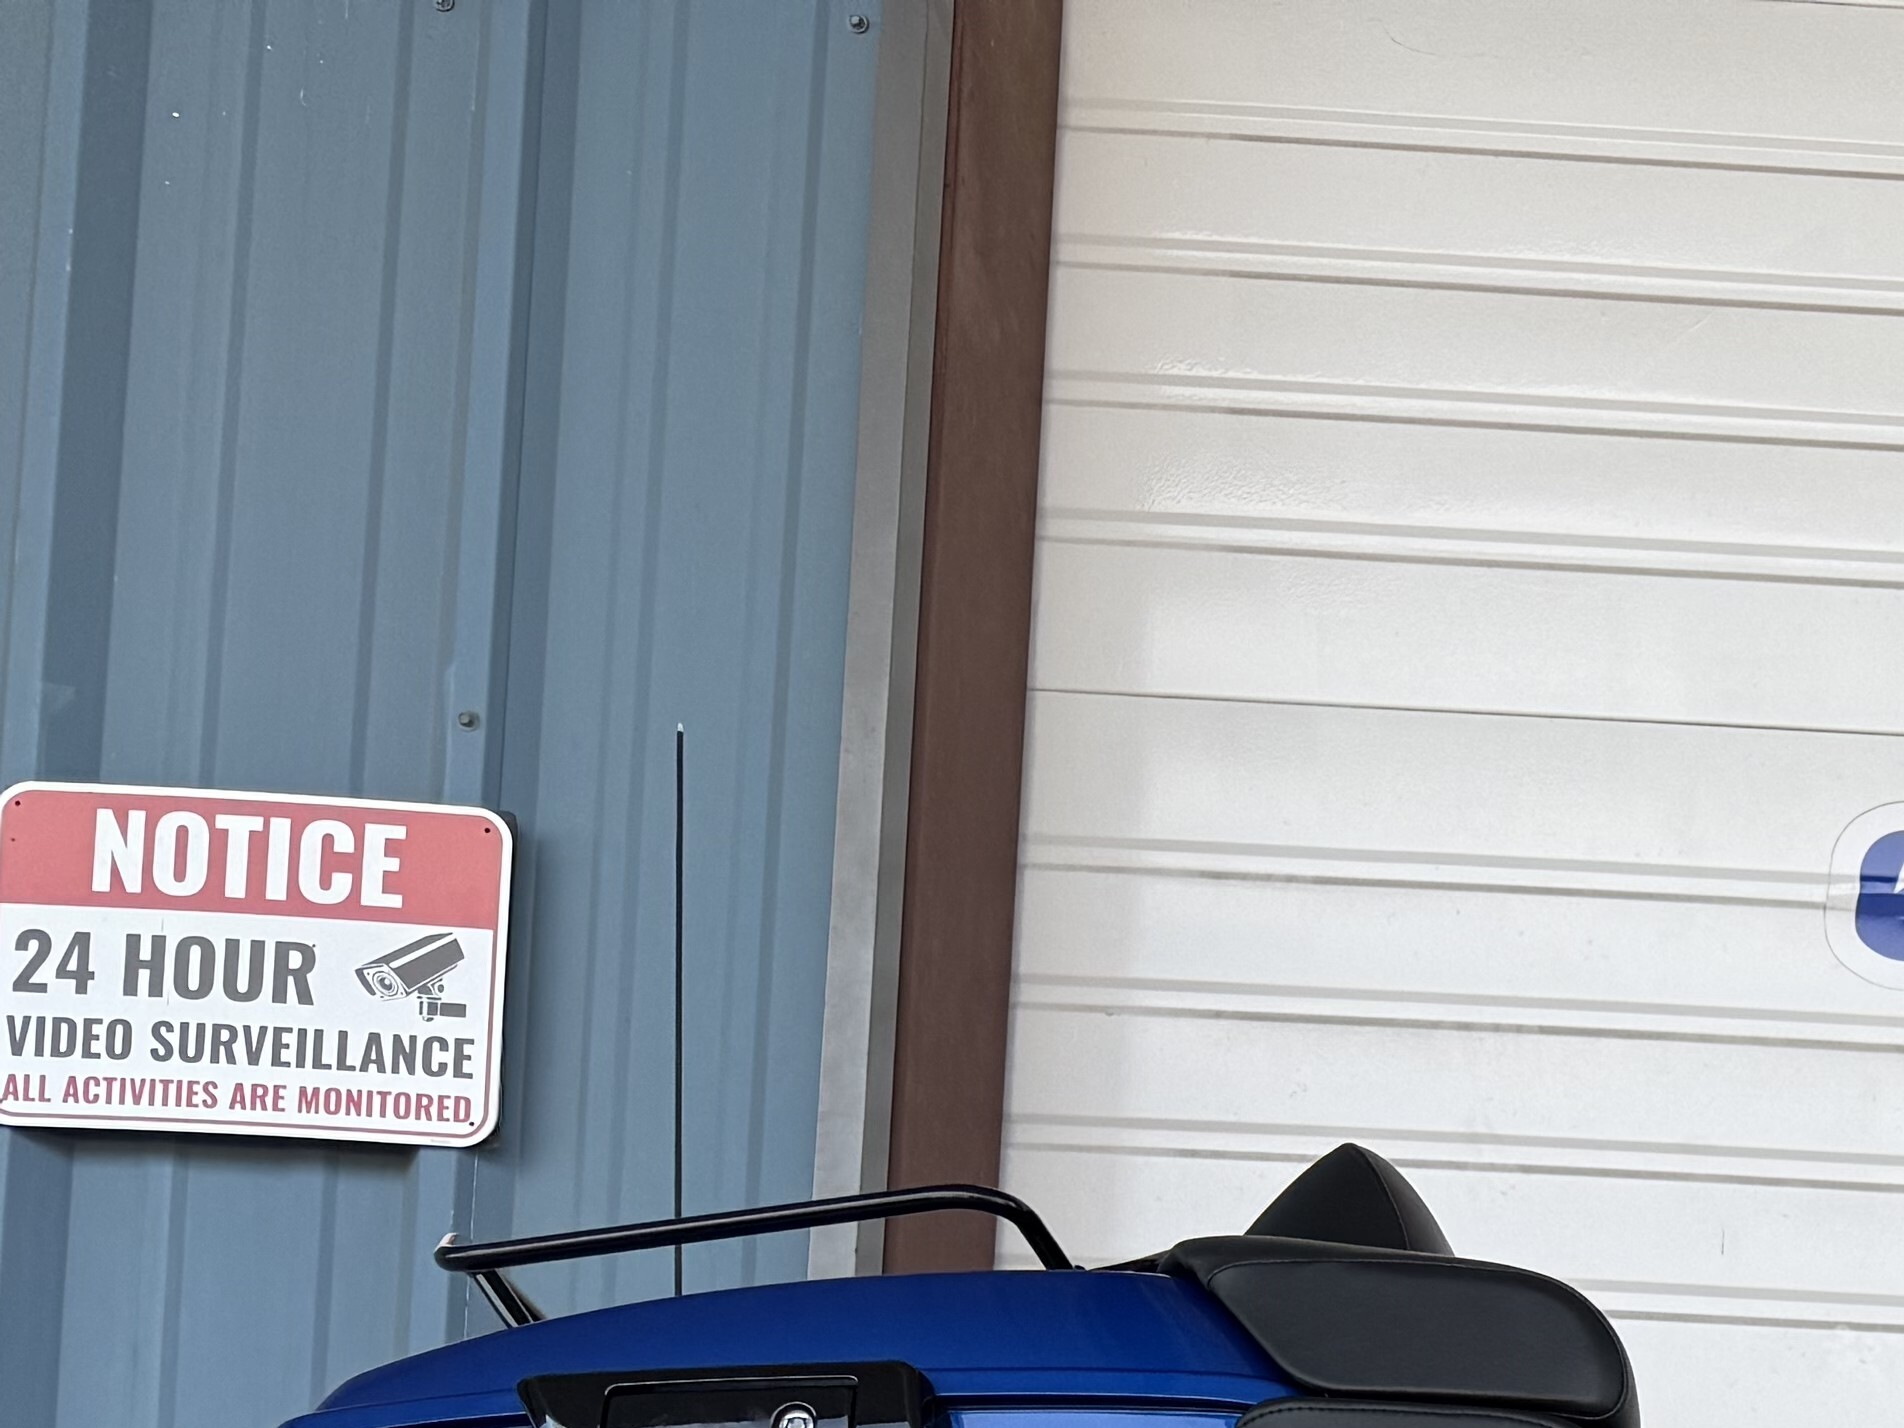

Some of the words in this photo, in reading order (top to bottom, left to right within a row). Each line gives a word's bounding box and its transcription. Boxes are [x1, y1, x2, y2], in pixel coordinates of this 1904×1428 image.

[91, 808, 407, 909] NOTICE
[12, 928, 95, 995] 24
[122, 932, 317, 1006] HOUR
[6, 1014, 133, 1061] VIDEO
[150, 1019, 476, 1080] SURVEILLANCE
[2, 1073, 52, 1103] ALL
[62, 1075, 219, 1109] ACTIVITIES
[228, 1082, 288, 1113] ARE
[297, 1086, 472, 1124] MONITORED
